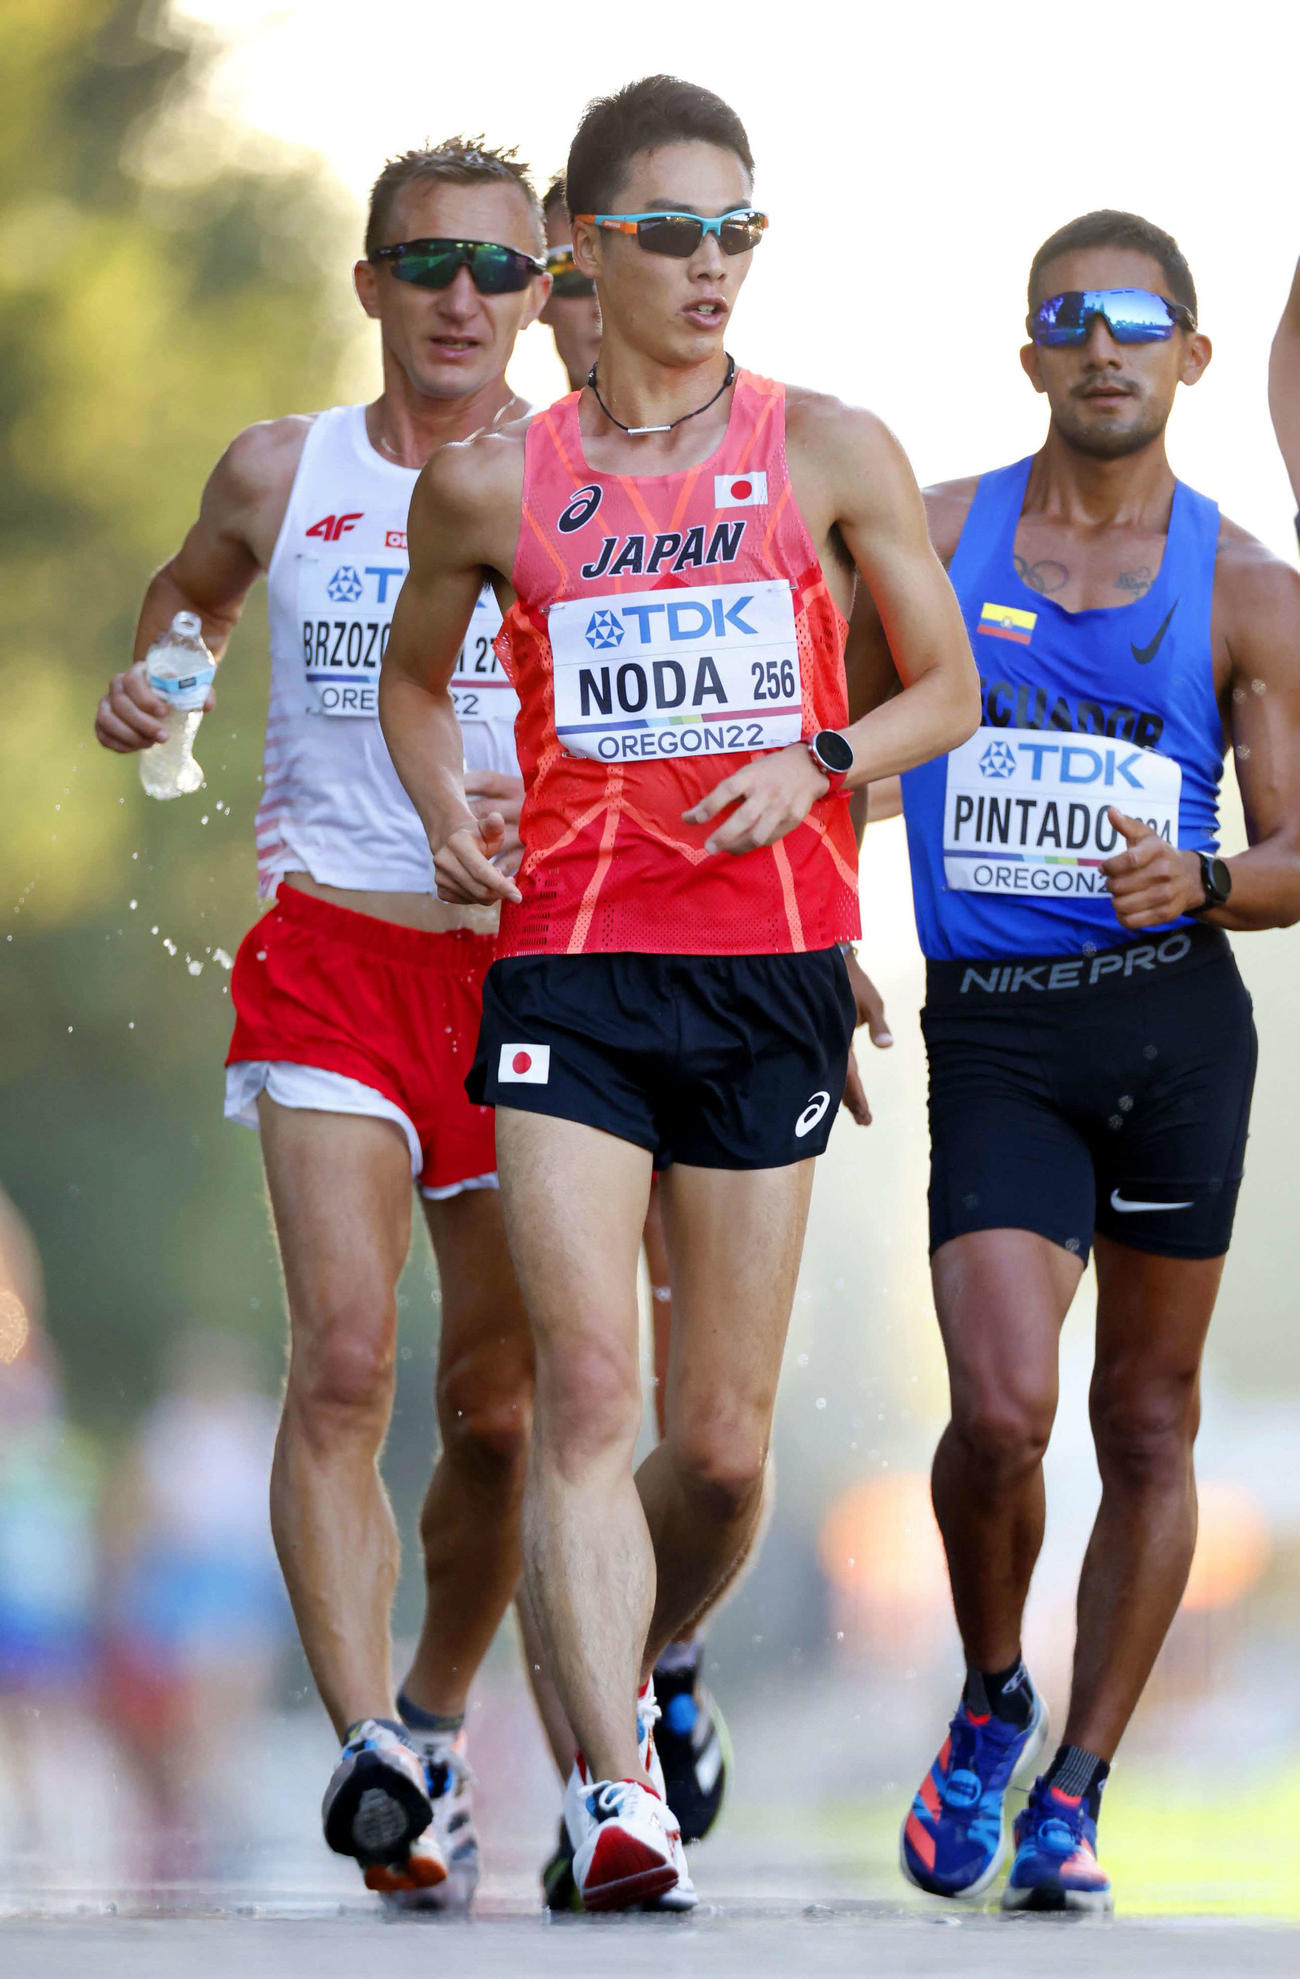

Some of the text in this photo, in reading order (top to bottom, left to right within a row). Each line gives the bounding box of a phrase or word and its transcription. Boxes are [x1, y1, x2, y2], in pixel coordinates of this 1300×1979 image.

[305, 512, 364, 541] 4F
[580, 520, 747, 580] JAPAN
[622, 596, 760, 644] TDK
[578, 656, 795, 717] NODA 256
[979, 676, 1164, 747] CUADOR
[598, 723, 764, 759] OREGON22
[1018, 743, 1145, 789] TDK
[953, 795, 1119, 852] PINTADO
[959, 934, 1191, 993] NIKE PRO
